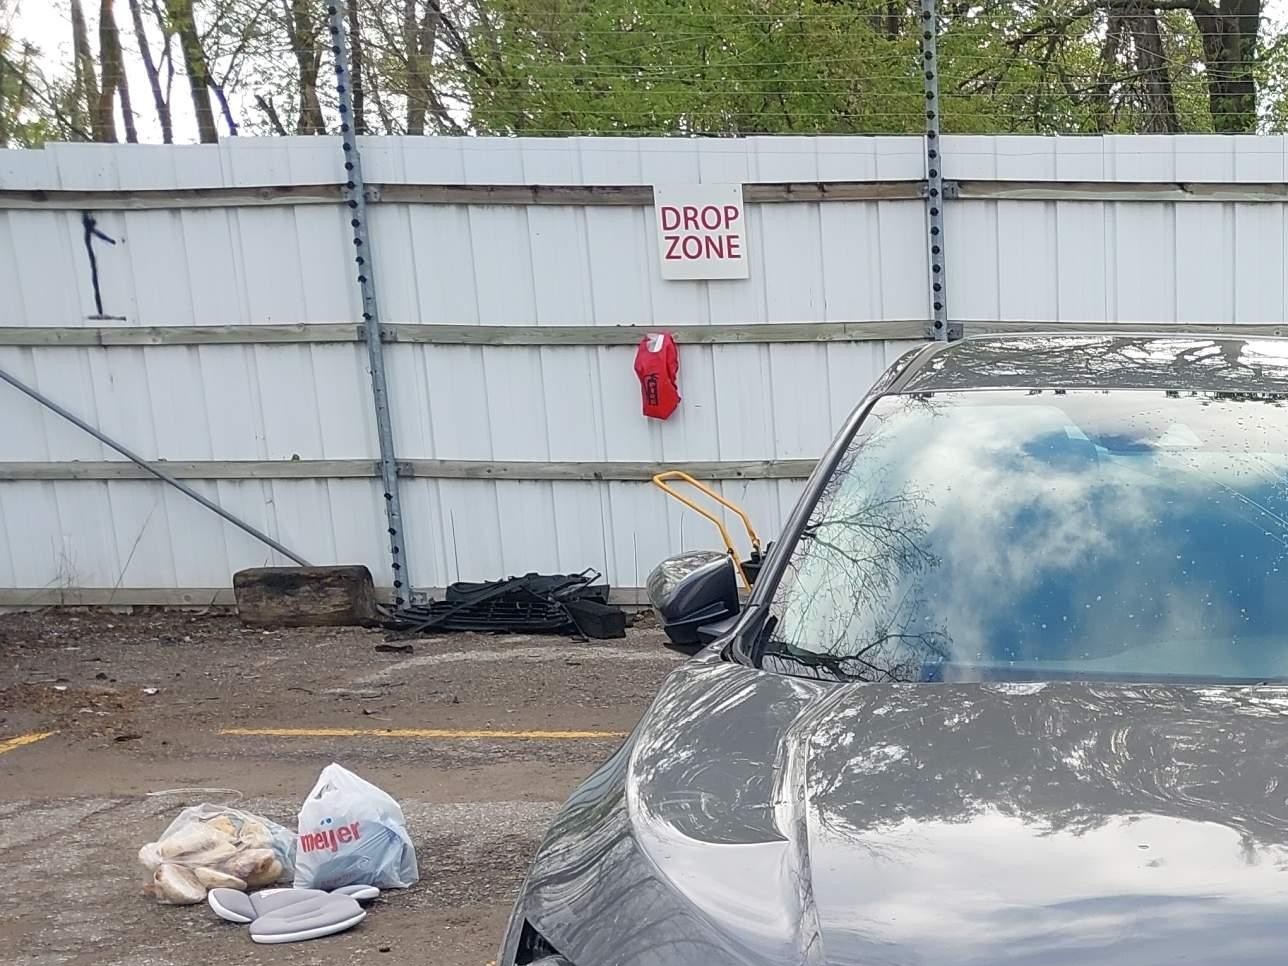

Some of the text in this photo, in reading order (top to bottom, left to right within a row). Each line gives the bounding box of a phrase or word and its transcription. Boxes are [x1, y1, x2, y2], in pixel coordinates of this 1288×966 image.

[660, 205, 740, 231] DROP
[663, 234, 742, 260] ZONE
[300, 817, 362, 853] meijer
